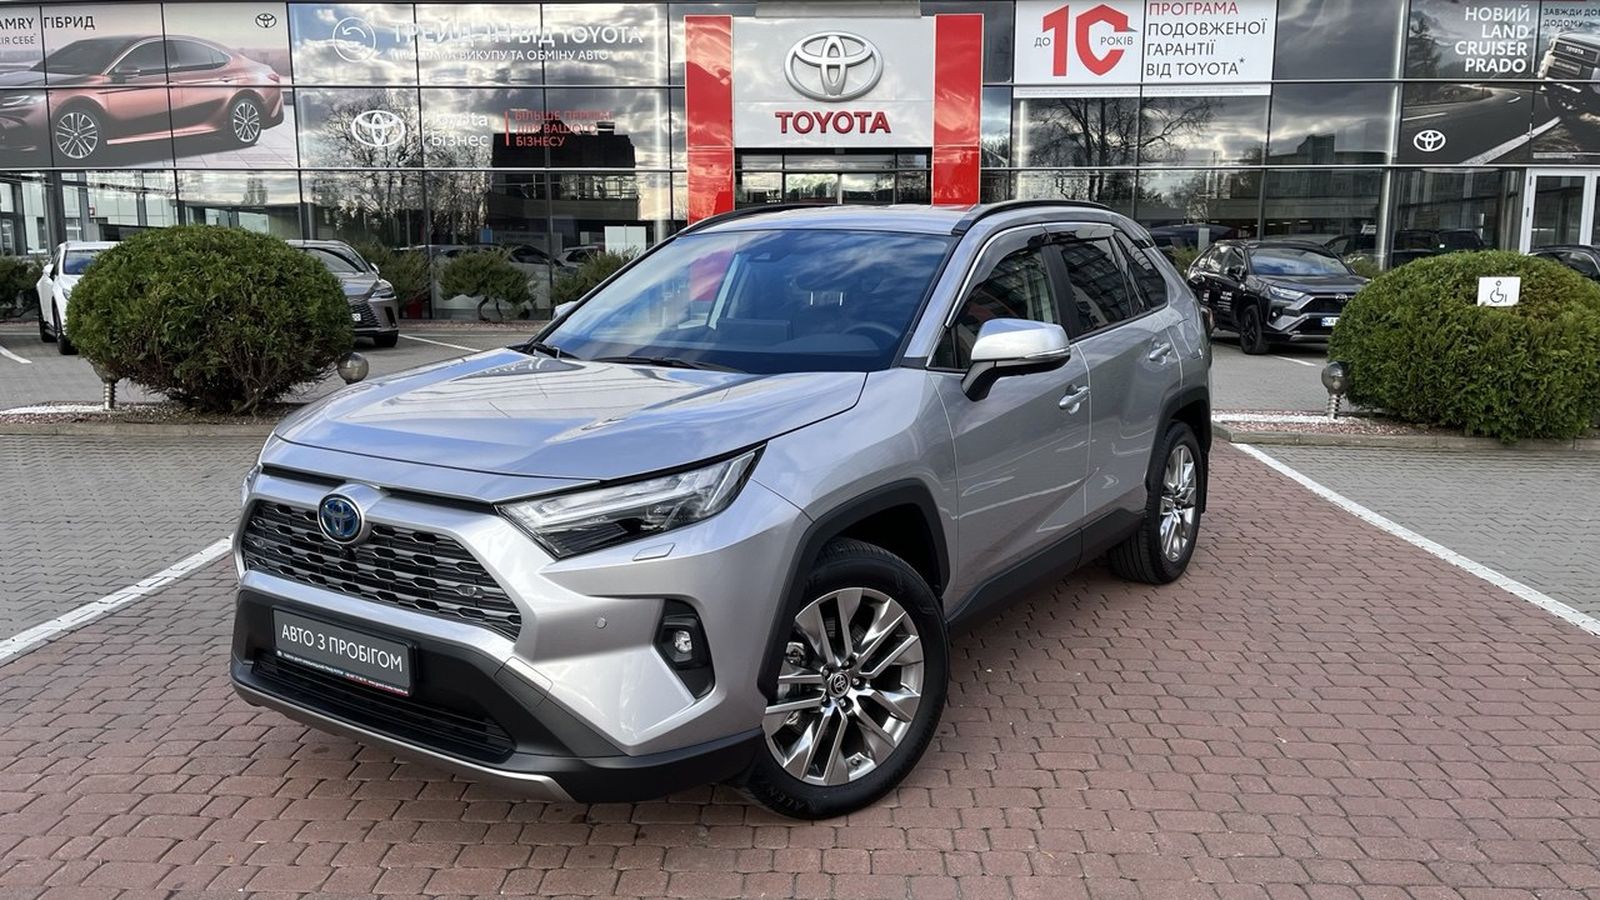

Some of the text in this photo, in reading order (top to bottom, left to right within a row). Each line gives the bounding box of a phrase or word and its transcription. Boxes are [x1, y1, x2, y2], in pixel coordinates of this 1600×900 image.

[1149, 2, 1239, 16] ПРОГРАМА
[1464, 4, 1531, 22] НОВИЙ
[1543, 8, 1583, 17] ЗАВЖДИ
[43, 16, 96, 31] ГІБРИД
[1148, 18, 1268, 38] ПОДОВЖЕНОЇ
[519, 26, 555, 47] ВІД
[561, 26, 643, 43] TOYOTA
[1481, 24, 1529, 39] LAND
[1034, 37, 1051, 47] ДО
[1100, 36, 1134, 46] РОКІВ
[1147, 40, 1215, 56] ГАРАНТІЇ
[1454, 41, 1528, 56] CRUISER
[460, 50, 508, 60] ВИКУПУ
[511, 50, 524, 60] ТА
[526, 50, 576, 60] ОБМІНУ
[1146, 63, 1172, 78] ВІД
[1464, 58, 1527, 73] PRADO
[775, 111, 892, 134] TOYOTA
[515, 136, 565, 147] БІЗНЕСУ
[281, 624, 315, 647] АВТО
[329, 637, 403, 672] ПРОБІГОМ
